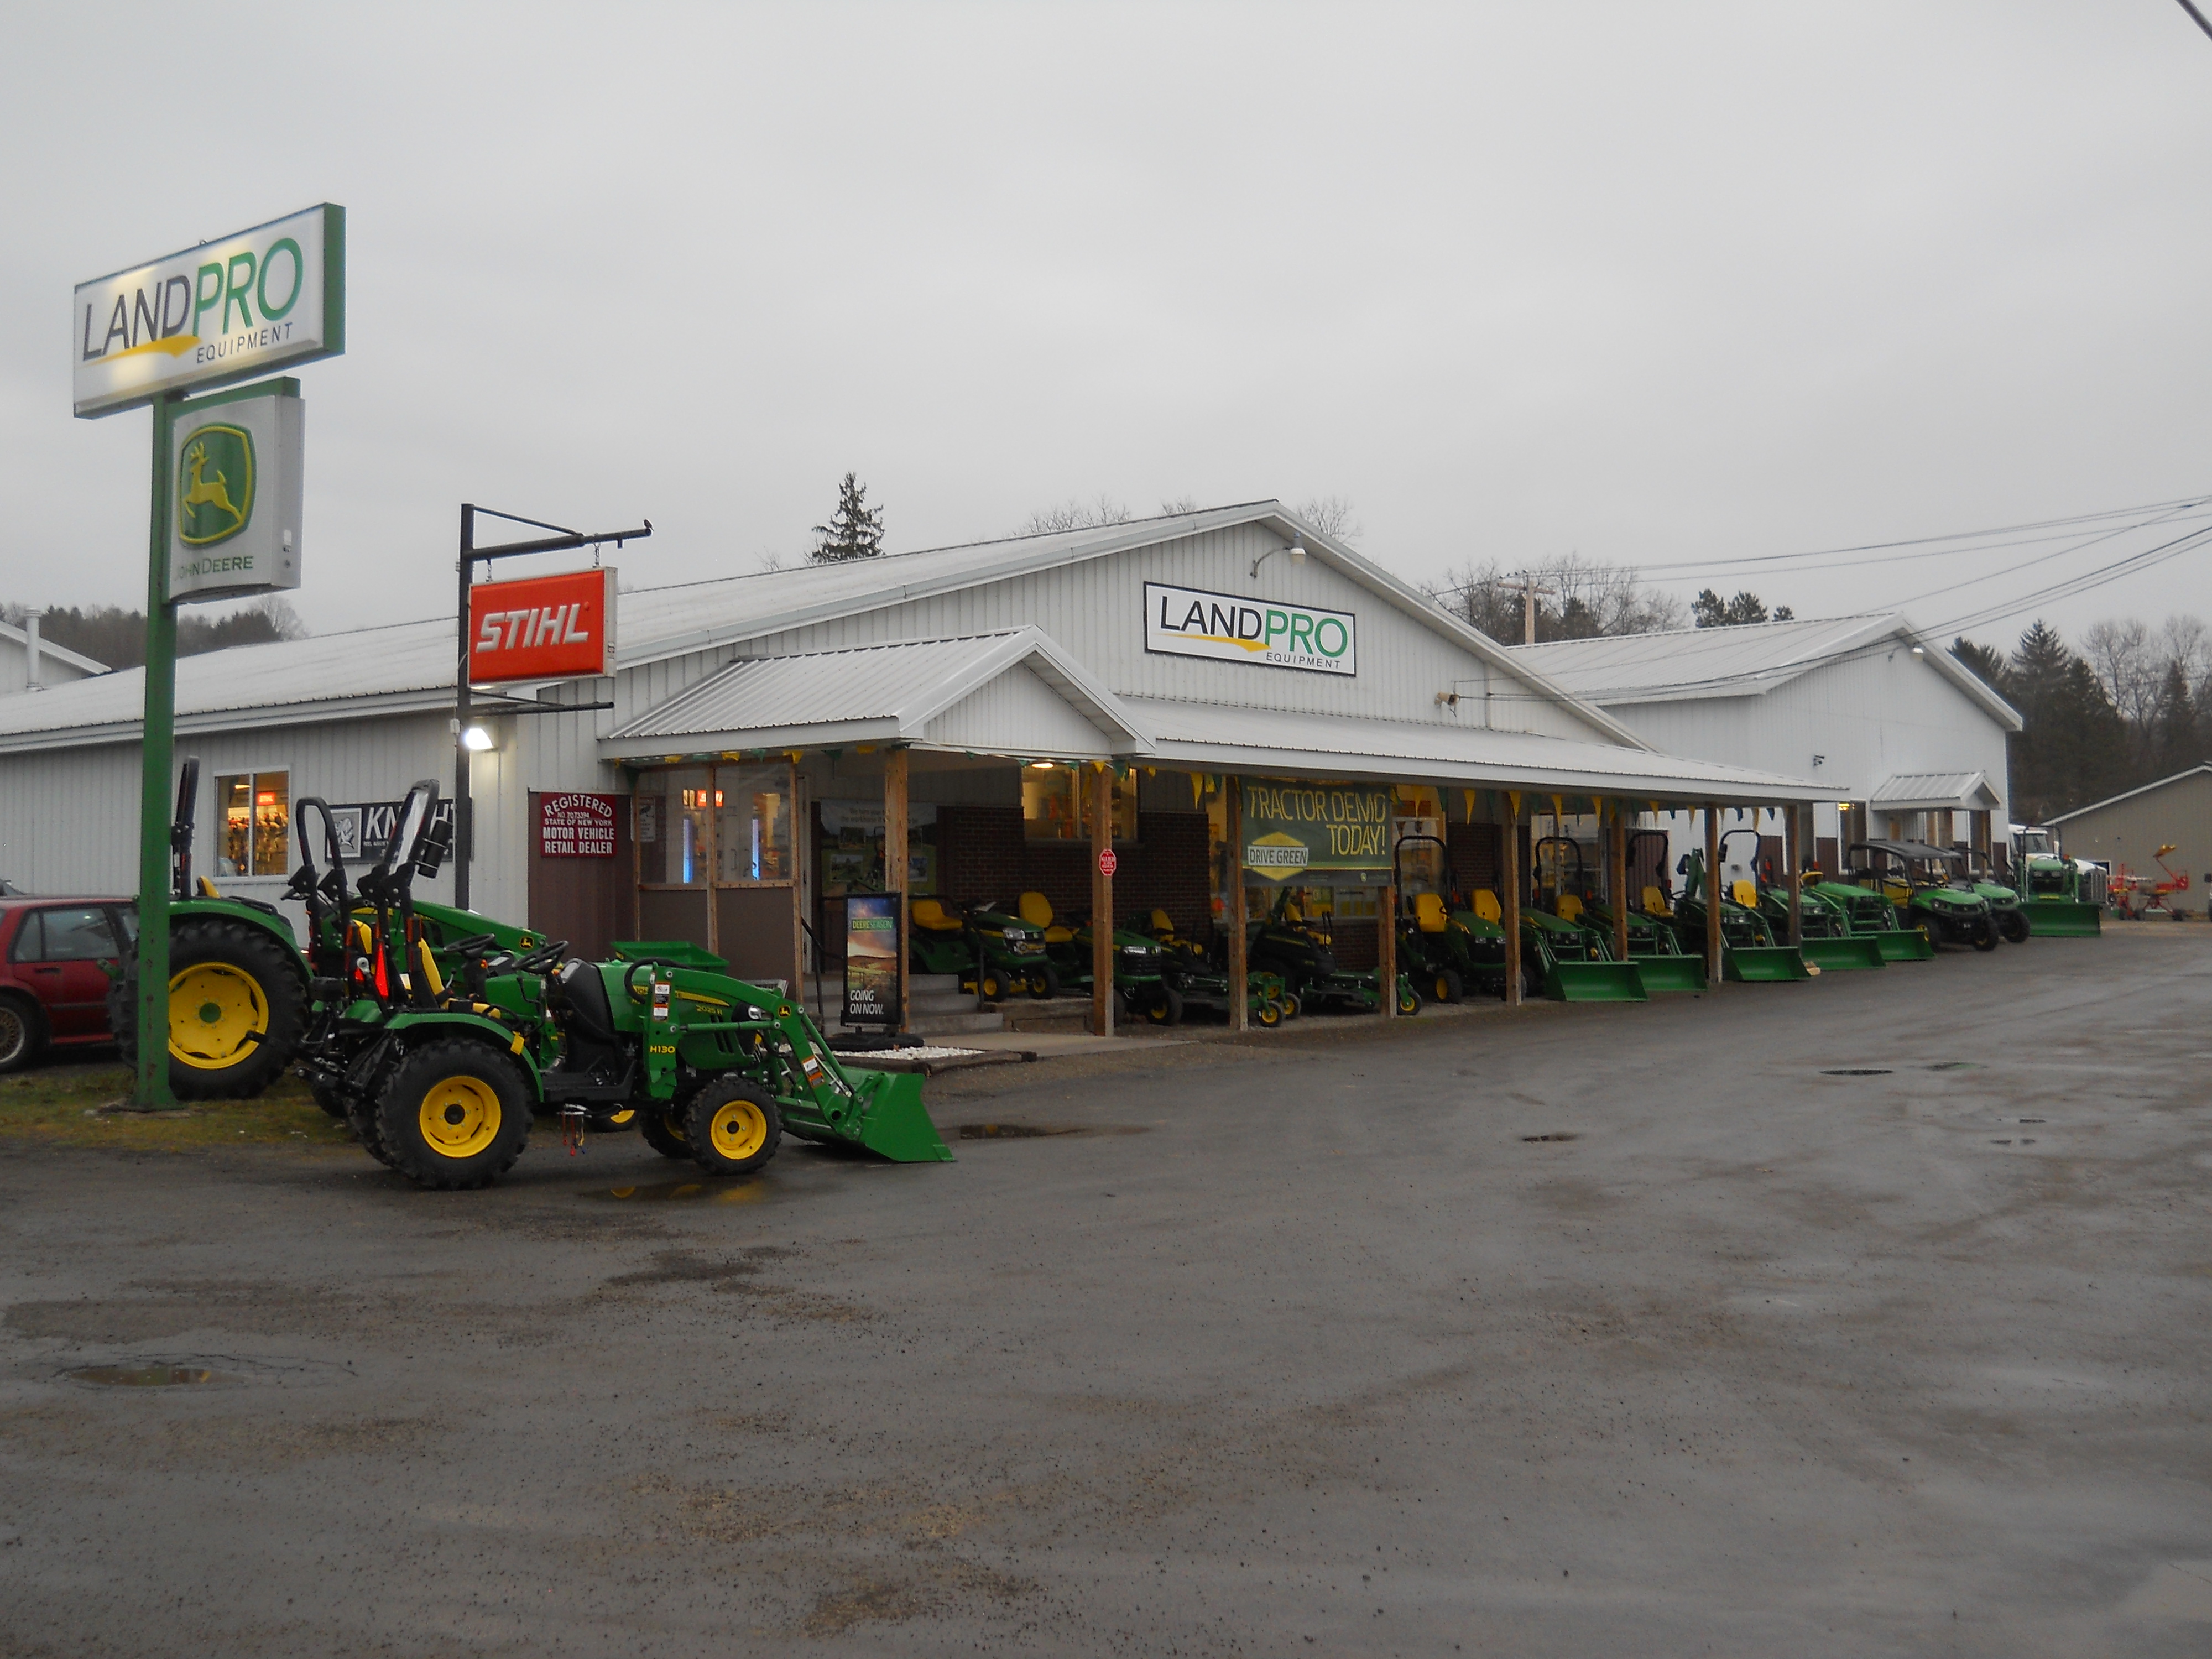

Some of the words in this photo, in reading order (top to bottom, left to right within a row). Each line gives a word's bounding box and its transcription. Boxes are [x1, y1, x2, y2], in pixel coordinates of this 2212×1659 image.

[83, 237, 304, 362] LANDPRO
[196, 322, 293, 364] EQUIPMENT
[202, 555, 254, 575] DEERE
[476, 603, 589, 653] STIHL
[1160, 596, 1348, 658] LANDPRO
[1266, 651, 1341, 669] EQUIPMENT
[544, 794, 613, 818] REGISTERED
[1247, 786, 1328, 822] TRACTOR
[1331, 791, 1386, 823] DEMO
[543, 827, 575, 839] MOTOR
[578, 827, 614, 840] VEHICLE
[1326, 824, 1385, 855] TODAY!
[545, 841, 576, 853] RETAIL
[579, 841, 612, 854] DEALER
[1249, 849, 1275, 864] DRIVE
[1276, 849, 1307, 864] GREEN
[850, 990, 874, 1001] GOING
[849, 1003, 862, 1014] ON
[863, 1003, 884, 1015] NOW.
[649, 1045, 676, 1053] H130
